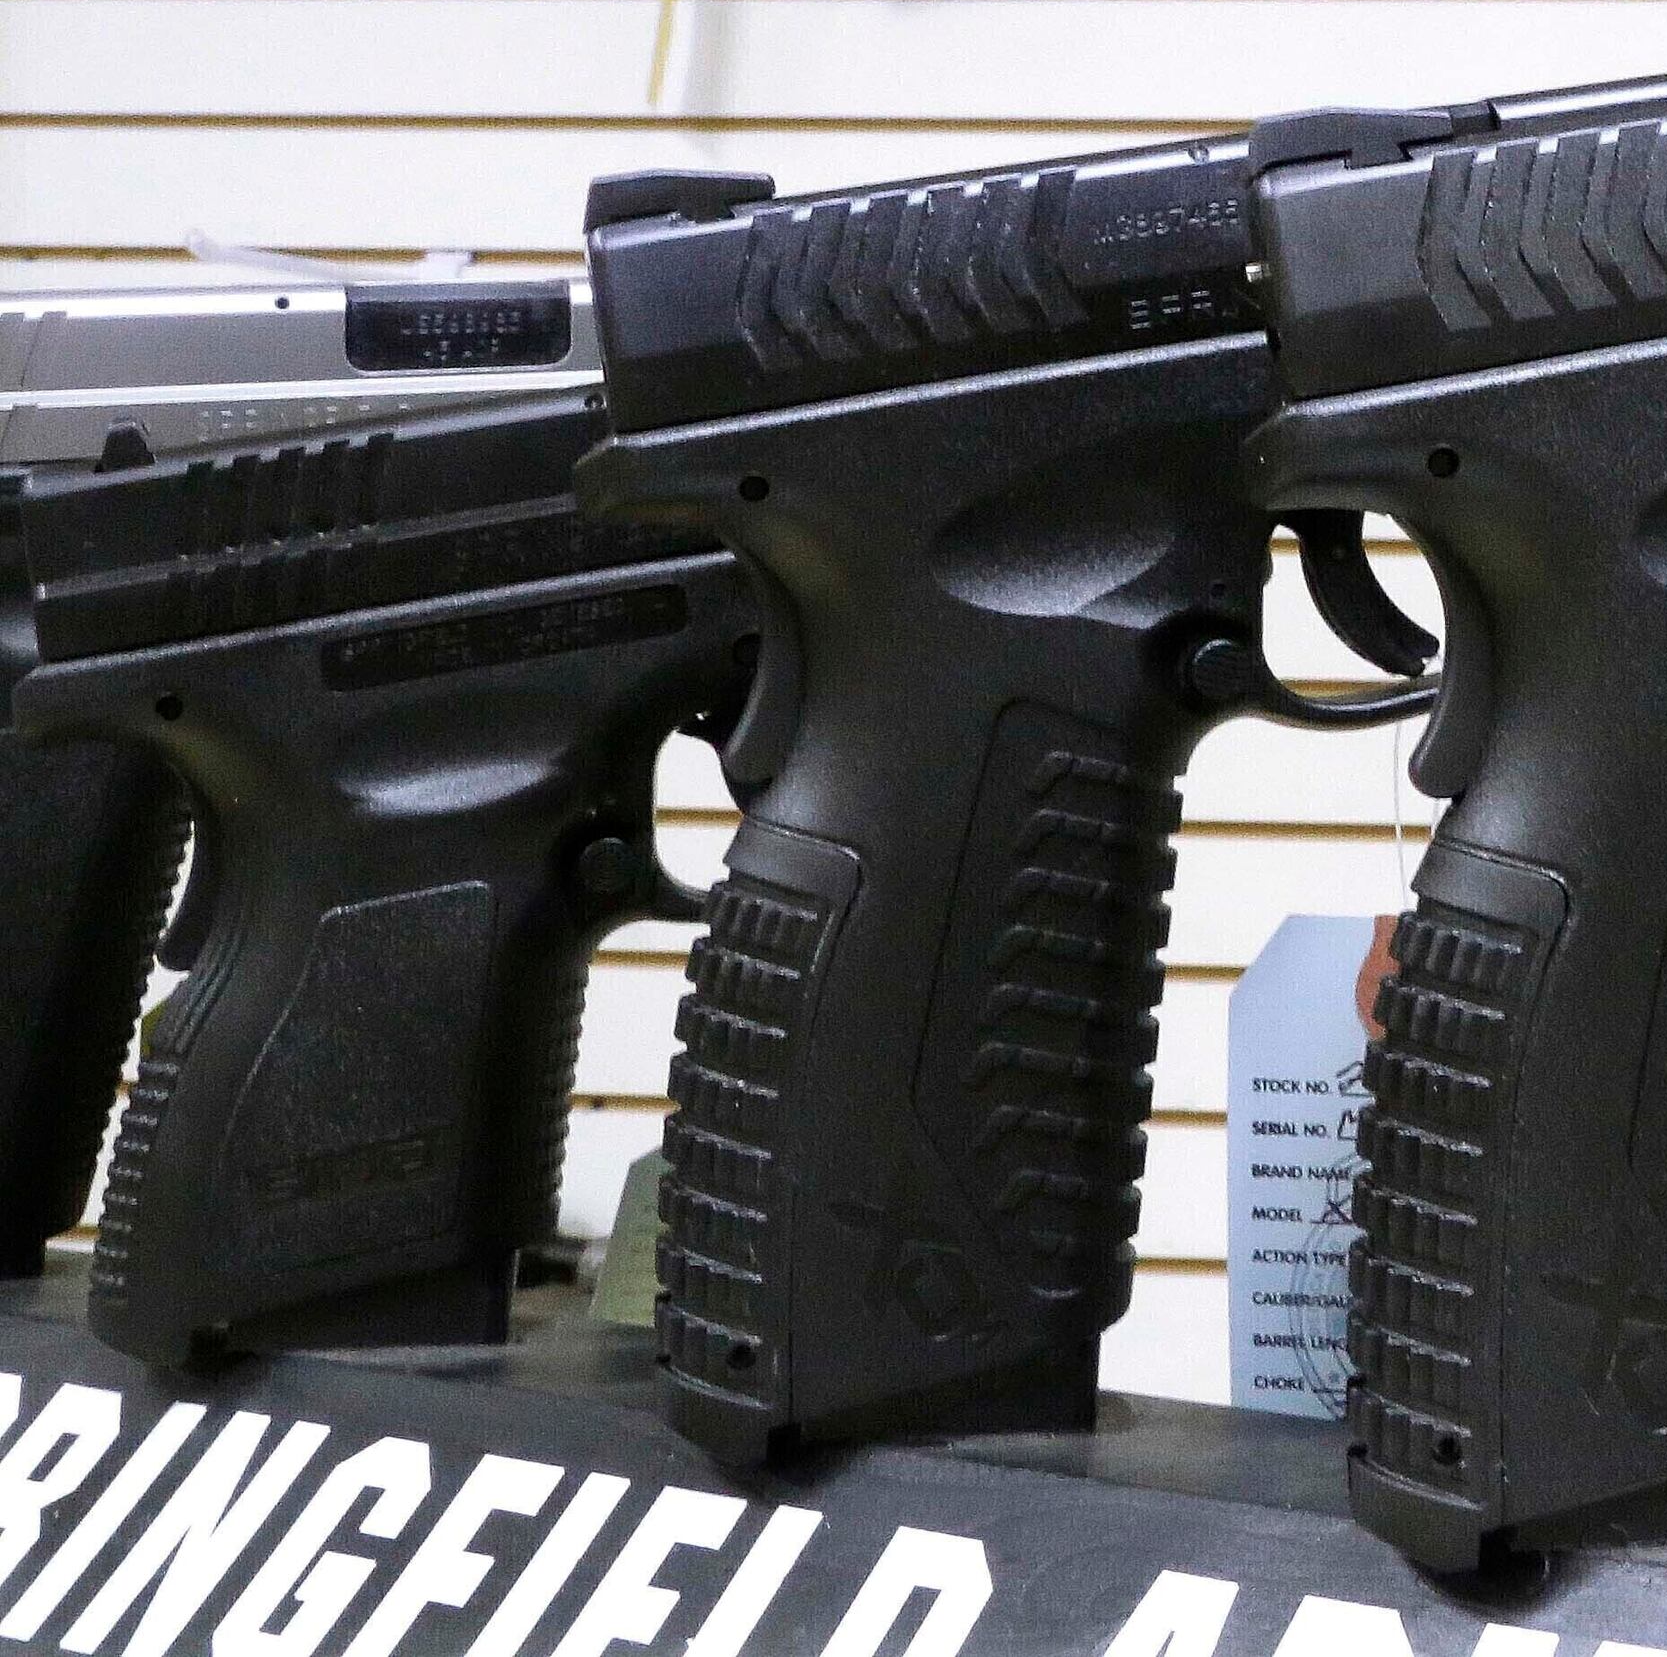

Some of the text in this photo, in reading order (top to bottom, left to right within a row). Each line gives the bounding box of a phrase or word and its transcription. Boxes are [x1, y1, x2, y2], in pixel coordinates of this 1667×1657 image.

[1252, 1077, 1300, 1093] STOCK
[1252, 1120, 1298, 1136] SERIAL
[1252, 1163, 1302, 1179] BRAND
[1252, 1206, 1303, 1223] MODEL
[1252, 1248, 1308, 1264] ACTION
[1253, 1375, 1304, 1391] CHOKE
[0, 1373, 994, 1657] RINGFIELD
